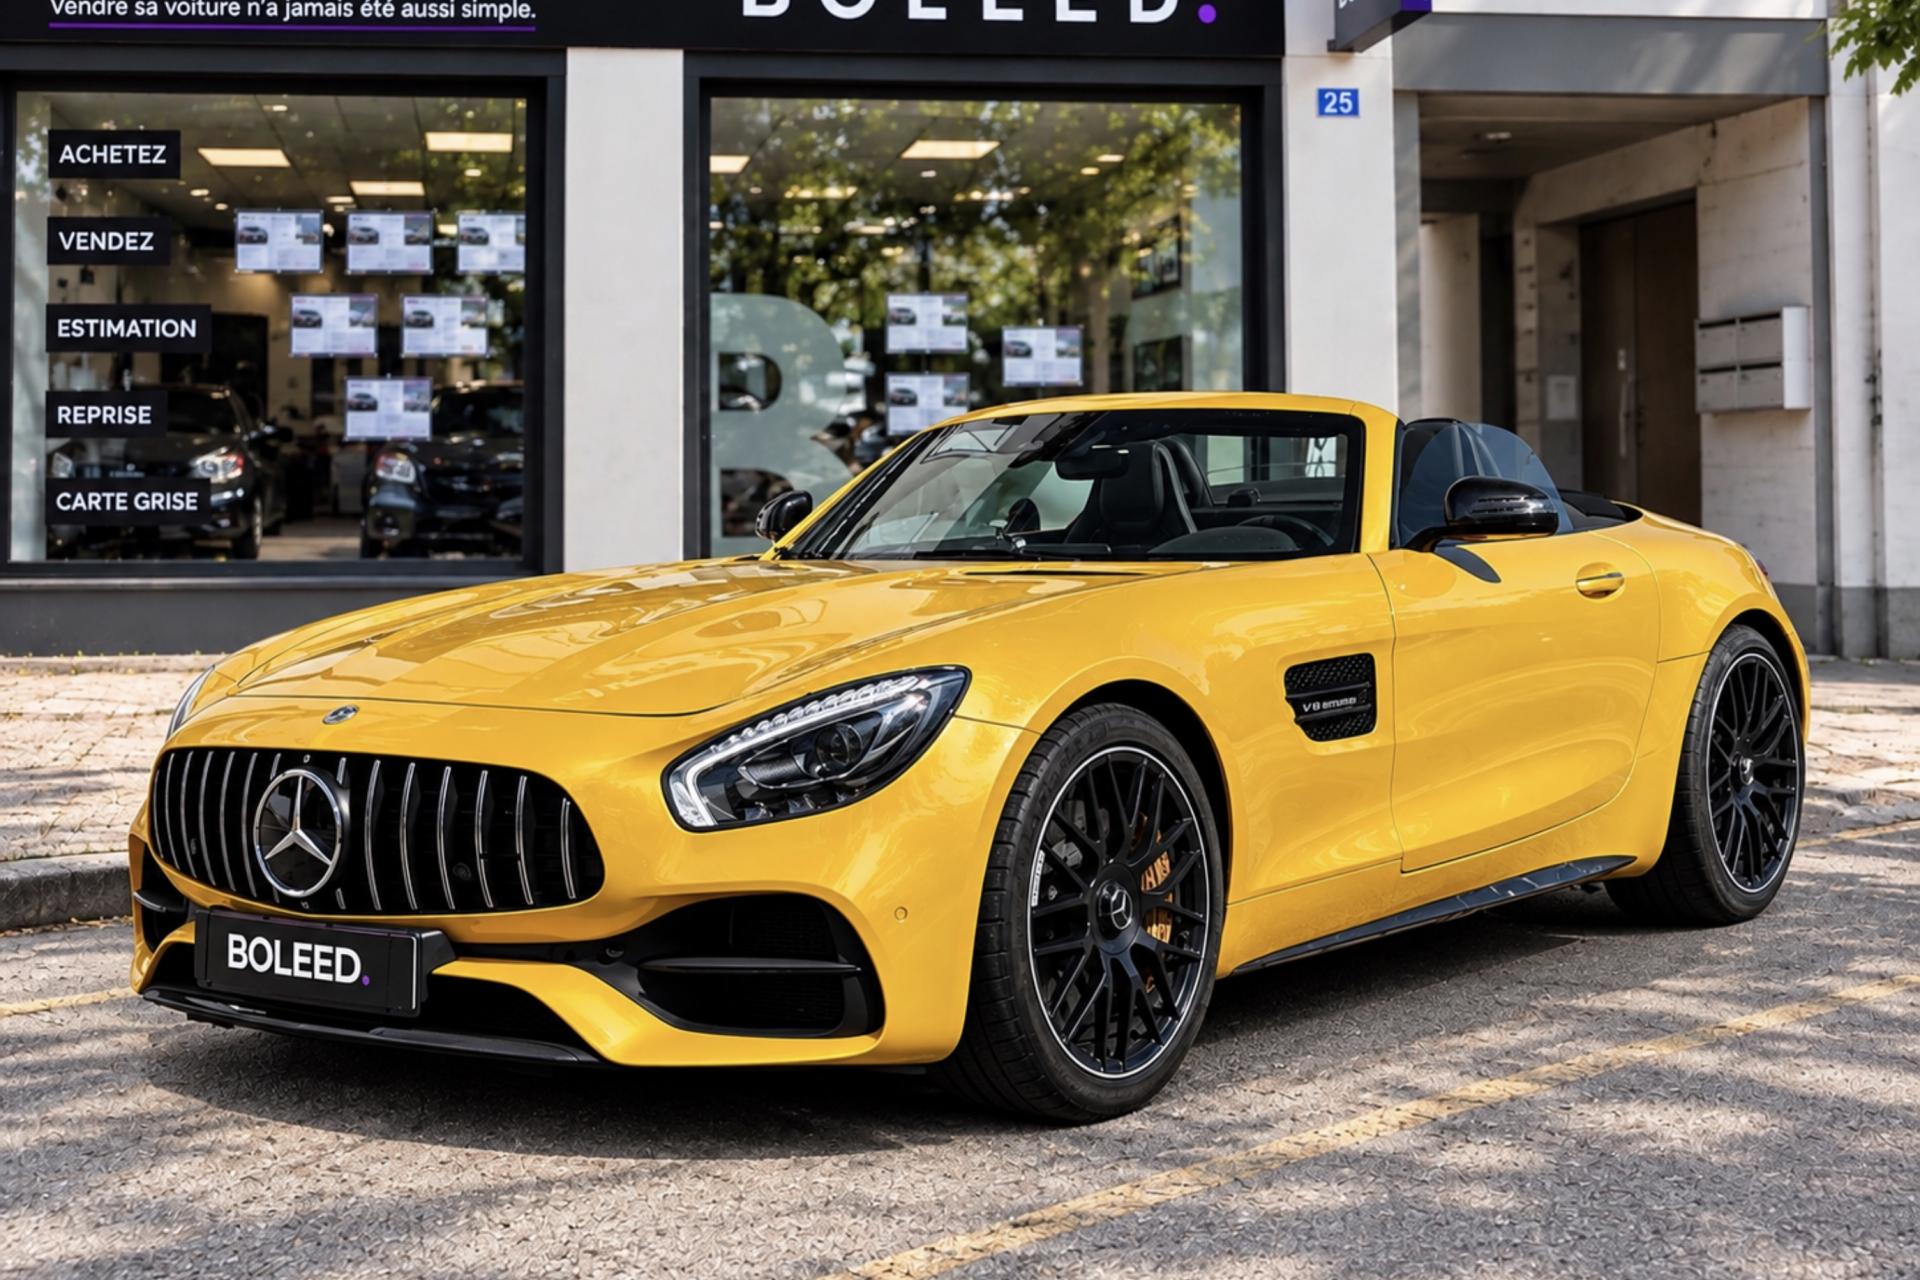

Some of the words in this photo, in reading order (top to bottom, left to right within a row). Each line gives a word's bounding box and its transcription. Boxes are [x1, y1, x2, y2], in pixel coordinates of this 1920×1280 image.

[51, 0, 128, 15] Vendre
[134, 0, 158, 16] sa
[164, 0, 241, 17] voiture
[283, 0, 354, 22] jamais
[360, 0, 395, 18] été
[401, 0, 455, 18] aussi
[461, 0, 536, 23] simple.
[1324, 91, 1353, 114] 25
[59, 144, 167, 164] ACHETEZ
[58, 231, 154, 251] VENDEZ
[57, 318, 196, 338] ESTIMATION
[57, 405, 152, 425] REPRISE
[56, 492, 128, 511] CARTE
[133, 492, 198, 511] GRISE
[228, 933, 370, 986] BOLEED.
